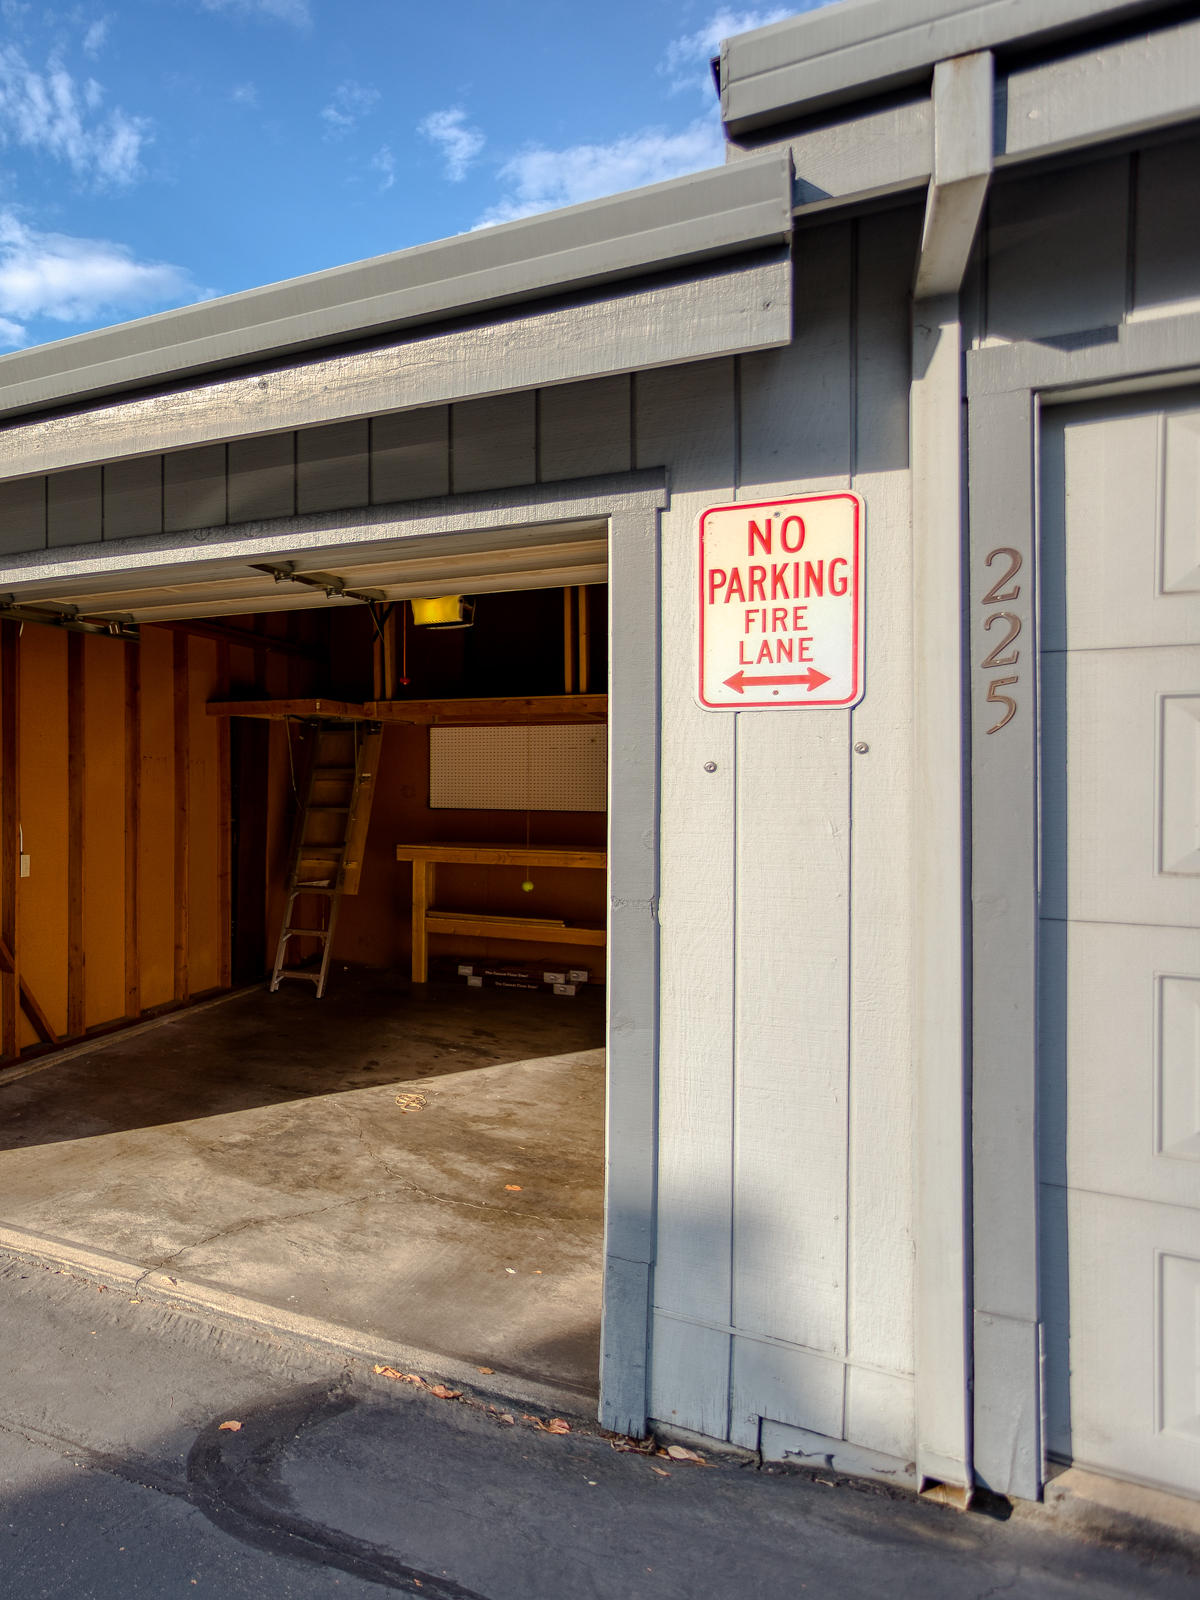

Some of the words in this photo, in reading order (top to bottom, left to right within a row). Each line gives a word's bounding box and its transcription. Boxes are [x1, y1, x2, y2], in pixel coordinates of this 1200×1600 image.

[748, 515, 806, 557] NO
[708, 557, 849, 605] PARKING
[744, 606, 809, 634] FIRE
[981, 547, 1023, 734] 225
[739, 637, 814, 665] LANE
